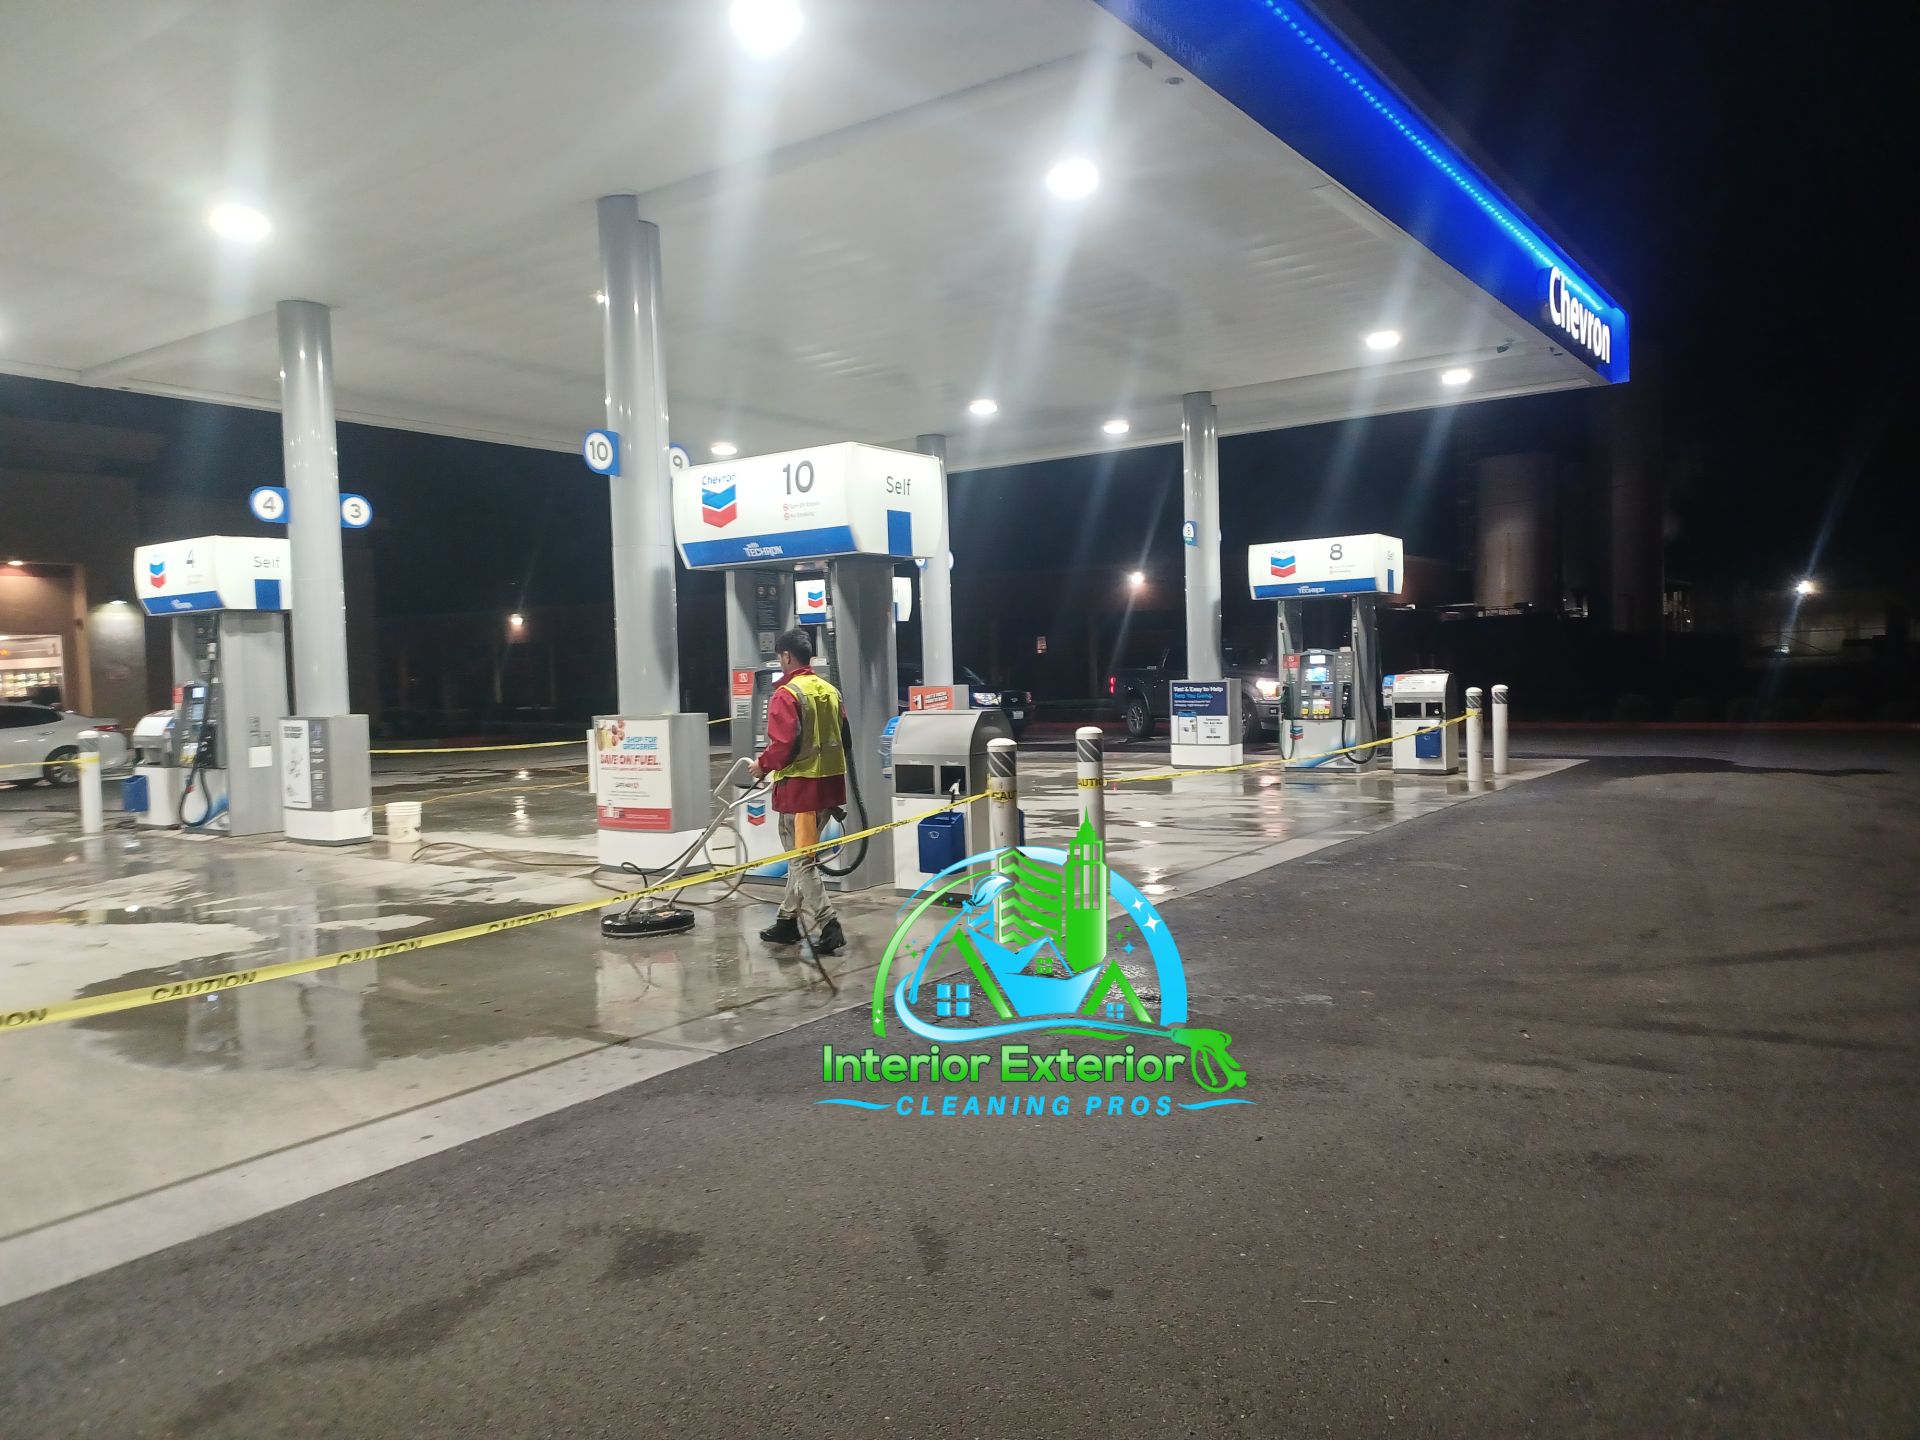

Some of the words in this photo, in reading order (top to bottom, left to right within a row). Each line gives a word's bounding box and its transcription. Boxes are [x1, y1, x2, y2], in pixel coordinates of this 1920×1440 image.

[1549, 266, 1610, 364] Chevron
[590, 442, 608, 461] 10
[672, 455, 684, 469] 9
[701, 474, 736, 486] Chevron
[782, 460, 814, 495] 10
[886, 475, 911, 495] Self
[262, 496, 276, 512] 4
[350, 503, 361, 518] 3
[185, 549, 195, 569] 4
[1329, 543, 1343, 561] 8
[253, 556, 281, 568] Self
[152, 970, 258, 1001] CAUTION
